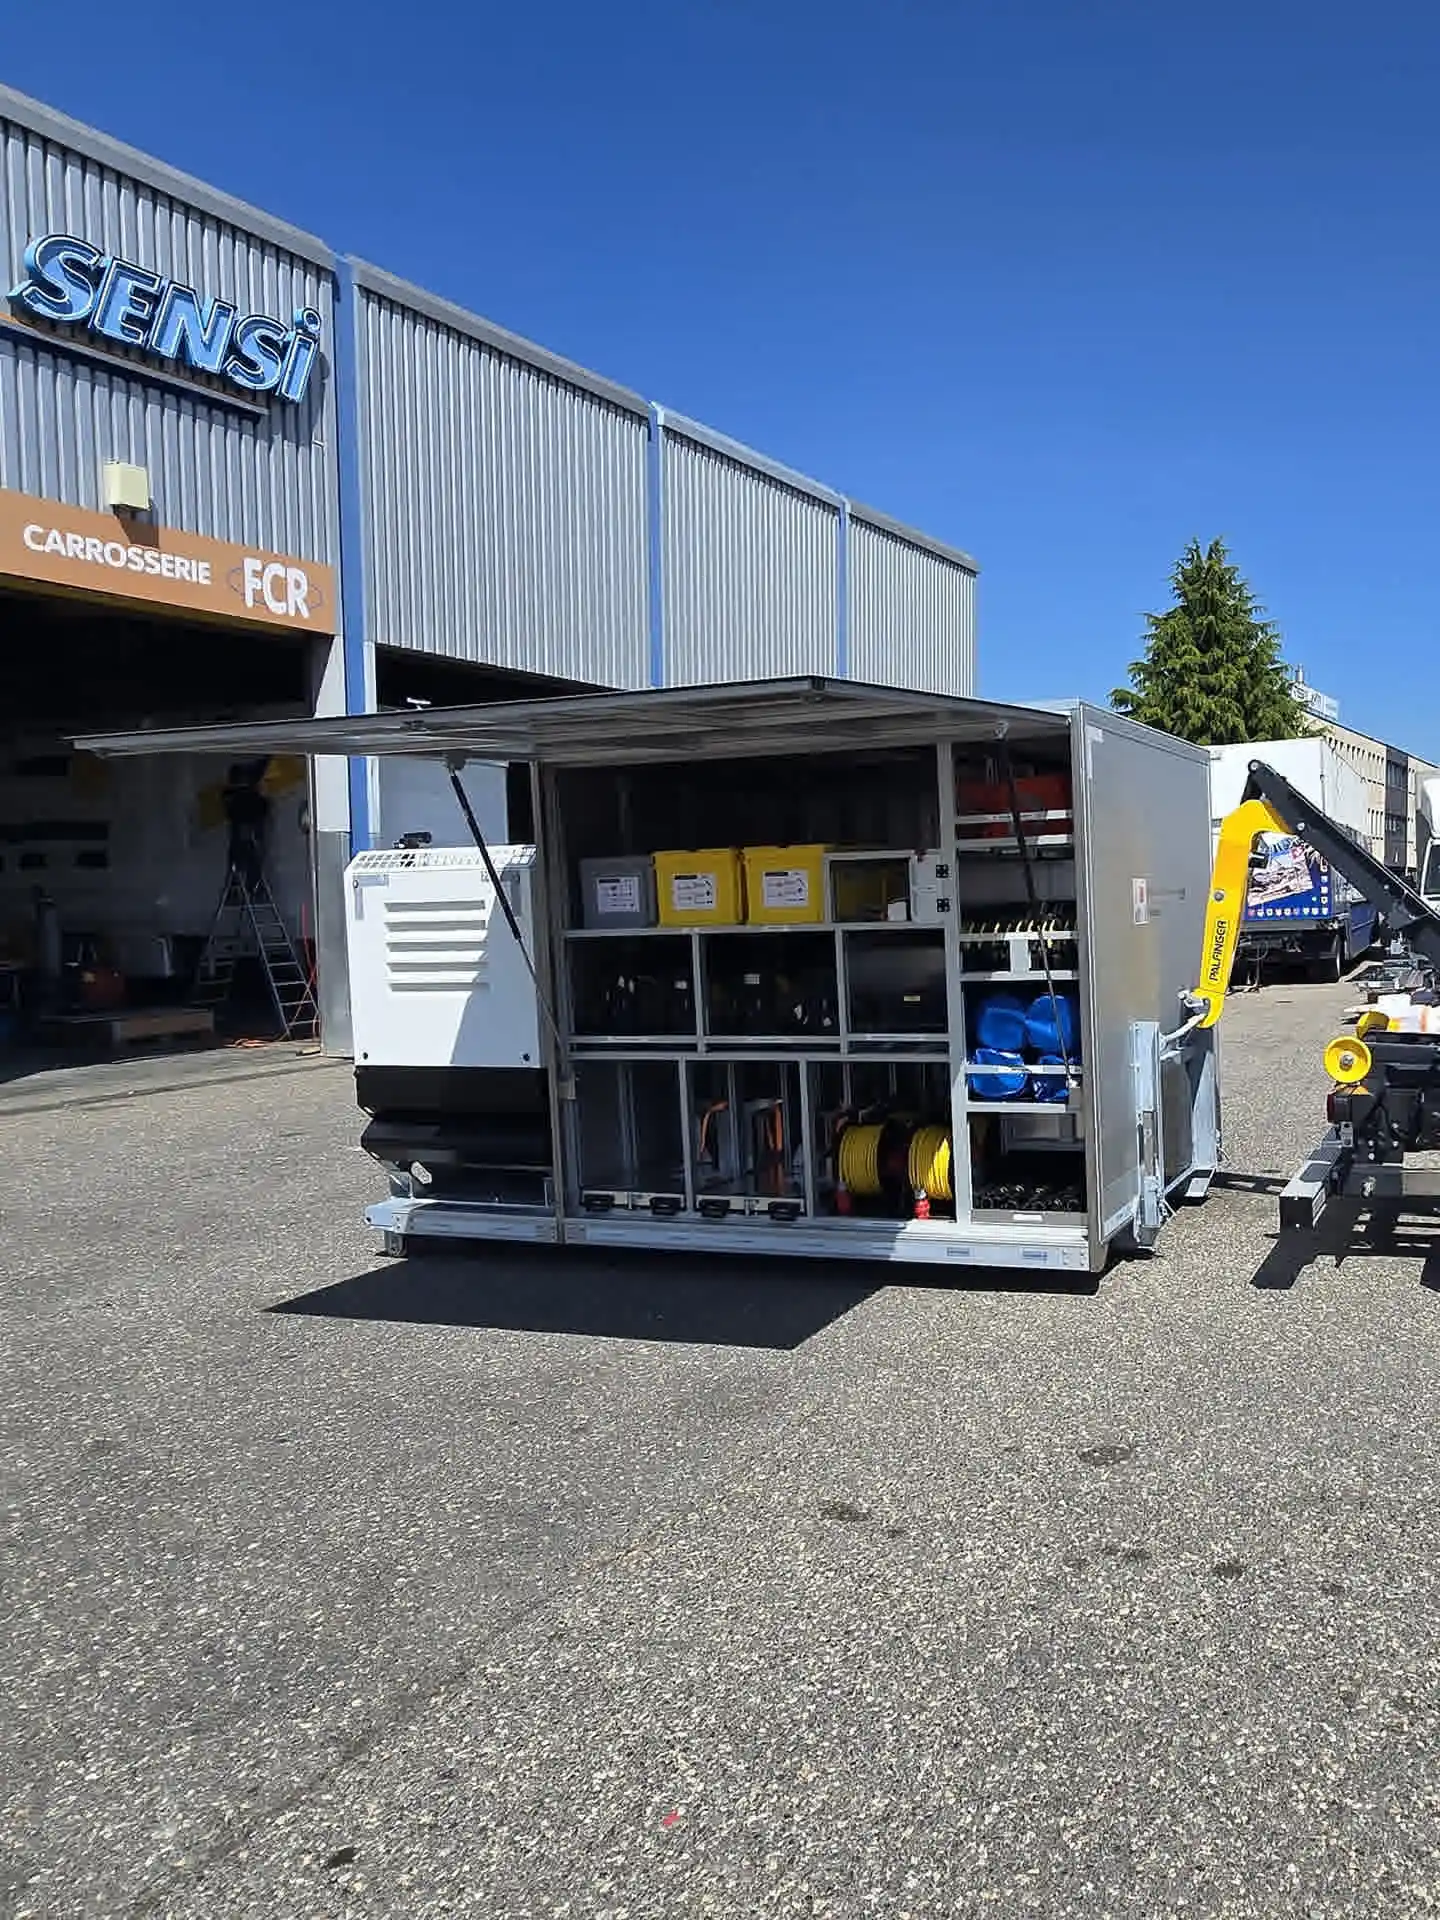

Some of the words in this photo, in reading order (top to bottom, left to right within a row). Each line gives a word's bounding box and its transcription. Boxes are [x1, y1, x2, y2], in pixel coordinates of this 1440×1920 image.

[23, 524, 211, 585] CARROSSERIE
[243, 557, 310, 618] FCR
[1209, 920, 1227, 981] PALFINGER
